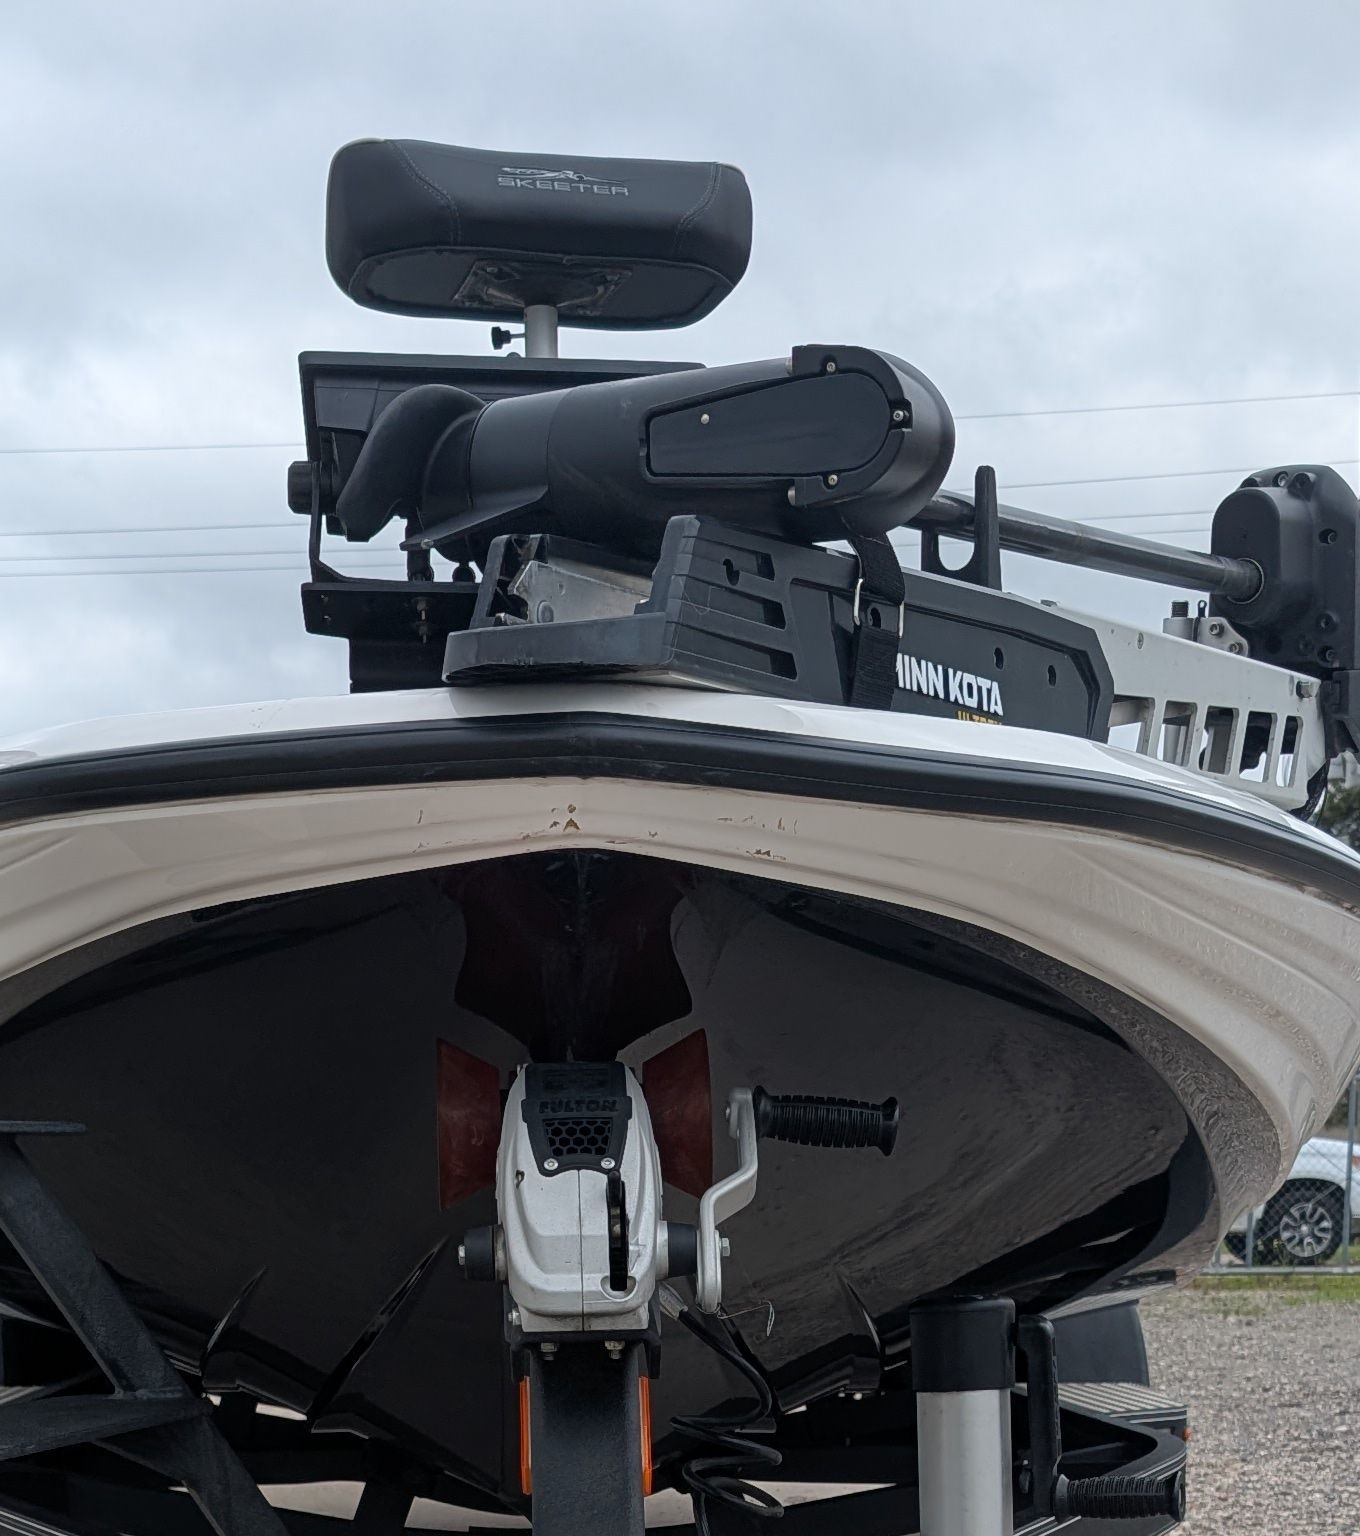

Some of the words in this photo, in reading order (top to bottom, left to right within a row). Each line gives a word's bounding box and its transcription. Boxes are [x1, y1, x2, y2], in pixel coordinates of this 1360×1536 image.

[497, 176, 629, 196] SKEETER
[948, 667, 1004, 717] KOTA
[539, 1099, 618, 1114] FULTON
